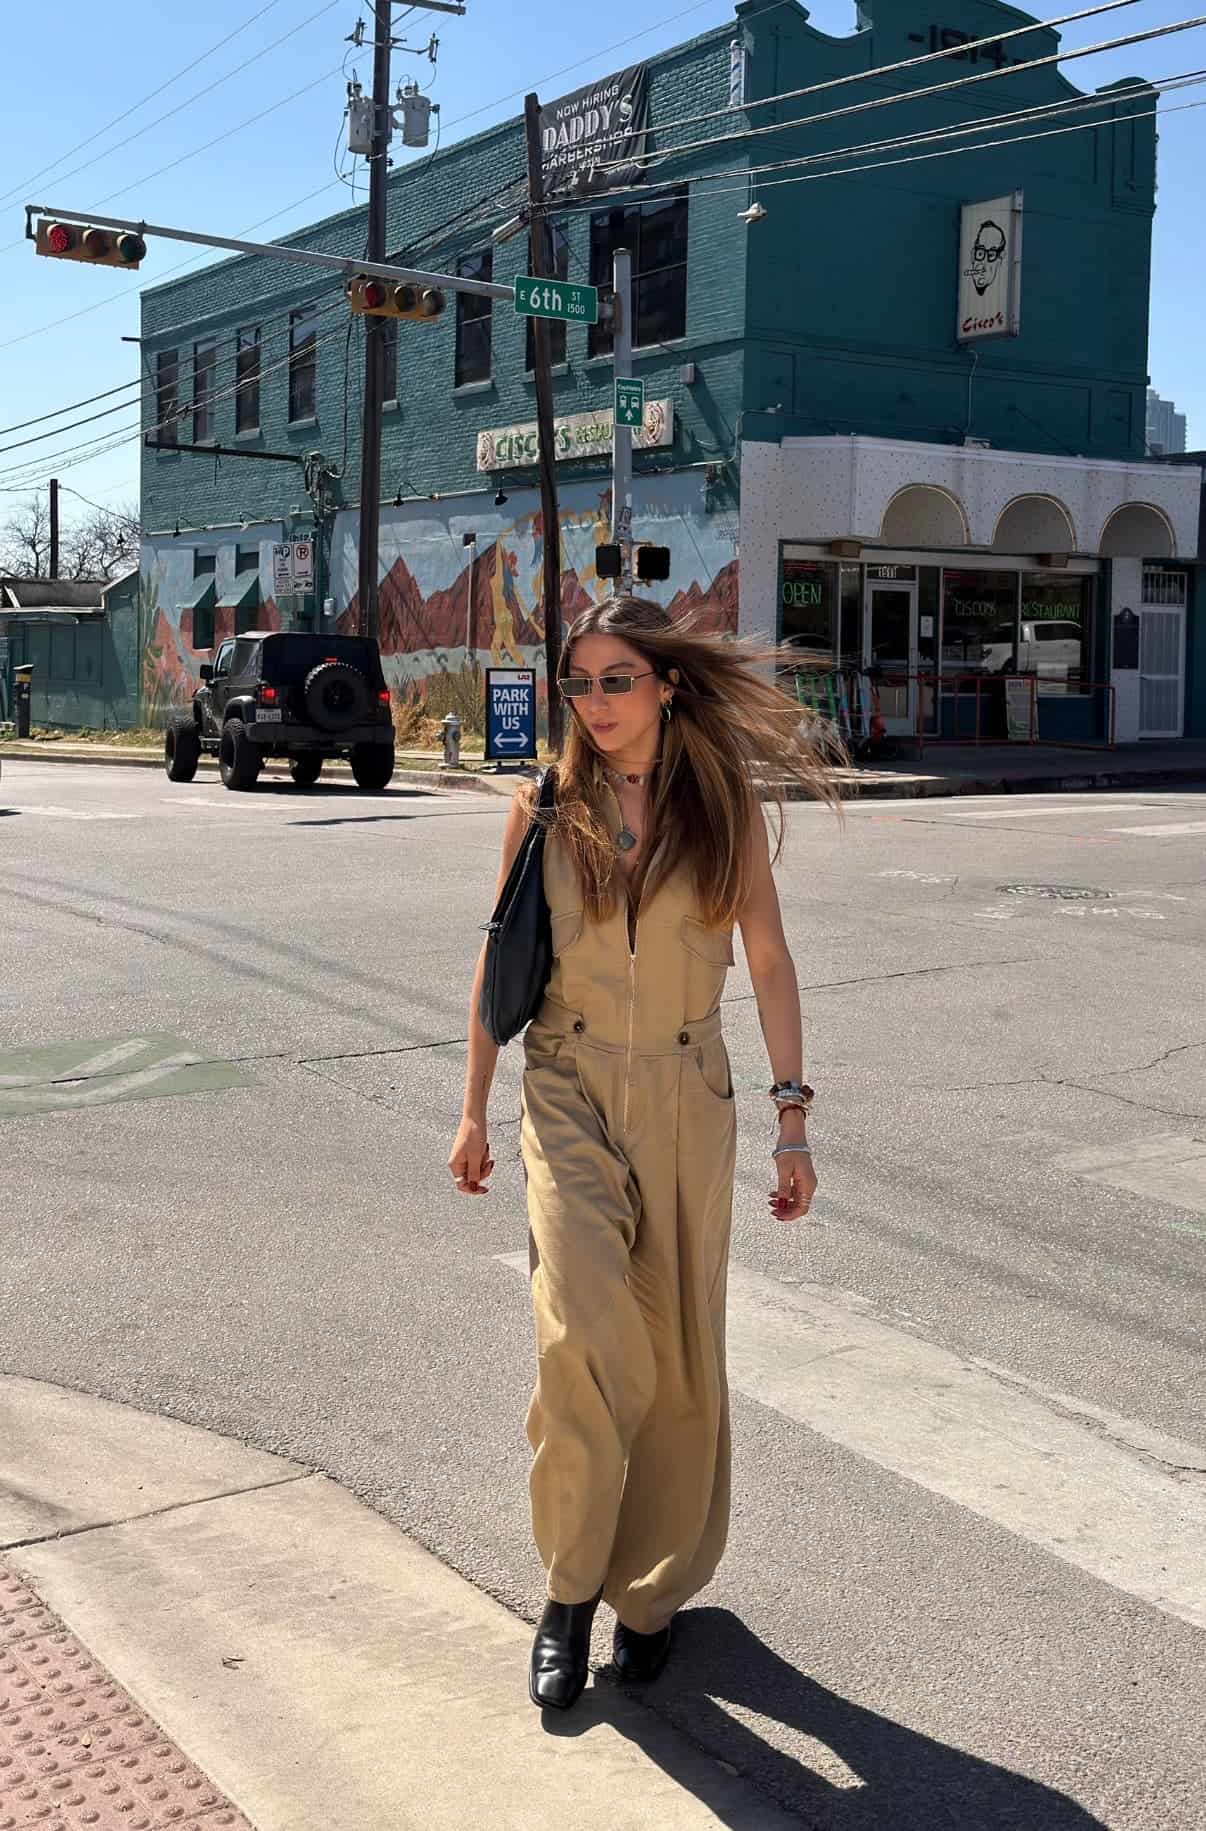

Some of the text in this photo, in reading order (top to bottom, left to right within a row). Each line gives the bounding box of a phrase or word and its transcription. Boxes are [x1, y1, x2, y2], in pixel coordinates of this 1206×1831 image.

[556, 84, 620, 120] NOW HIRING
[542, 94, 634, 152] DADDY'S
[519, 286, 581, 312] E 6th ST
[567, 303, 586, 315] 1500
[495, 425, 570, 461] CISCS
[783, 582, 822, 605] OPEN
[493, 688, 529, 702] PARK
[494, 702, 529, 716] WITH
[502, 716, 521, 730] US
